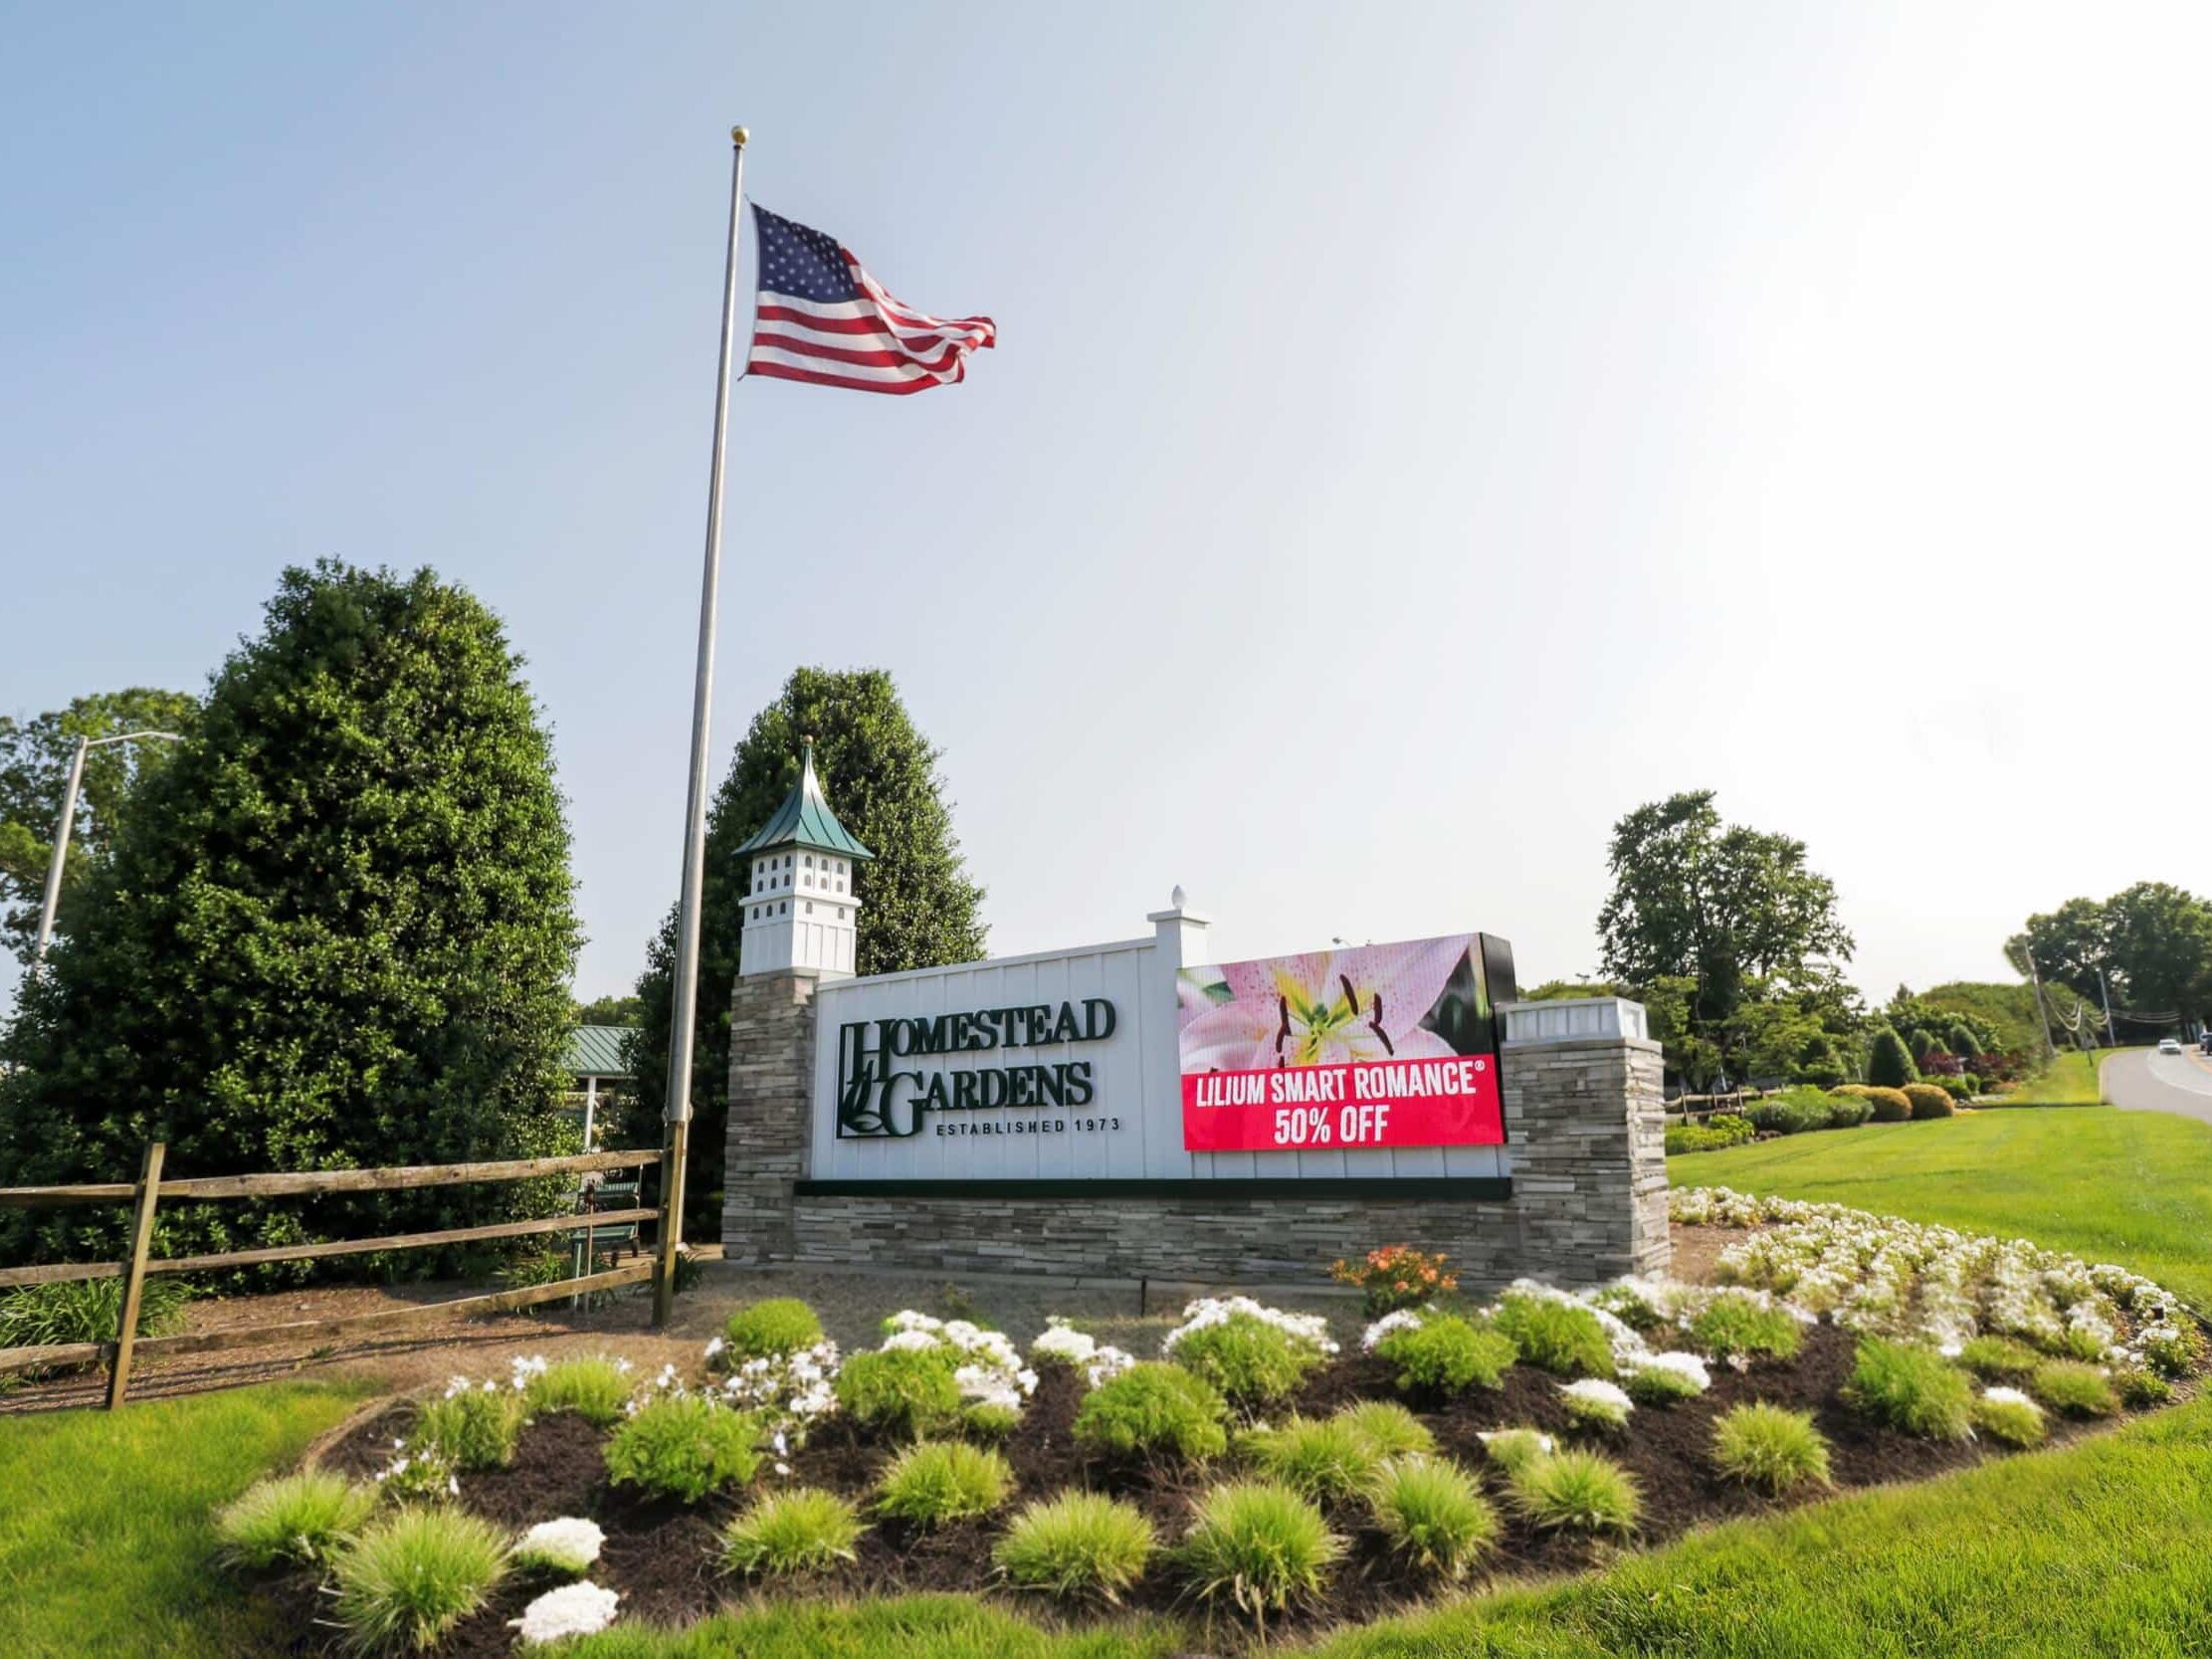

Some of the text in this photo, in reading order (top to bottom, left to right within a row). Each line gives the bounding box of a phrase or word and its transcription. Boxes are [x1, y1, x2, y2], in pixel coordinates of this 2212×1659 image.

[847, 998, 1116, 1085] HOMESTEAD
[880, 1061, 1094, 1138] GARDENS
[1196, 1074, 1265, 1107] LILIUM
[1271, 1069, 1347, 1104] SMART
[936, 1118, 1120, 1137] ESTABLISHED 1973
[1274, 1105, 1390, 1144] 50% OFF
